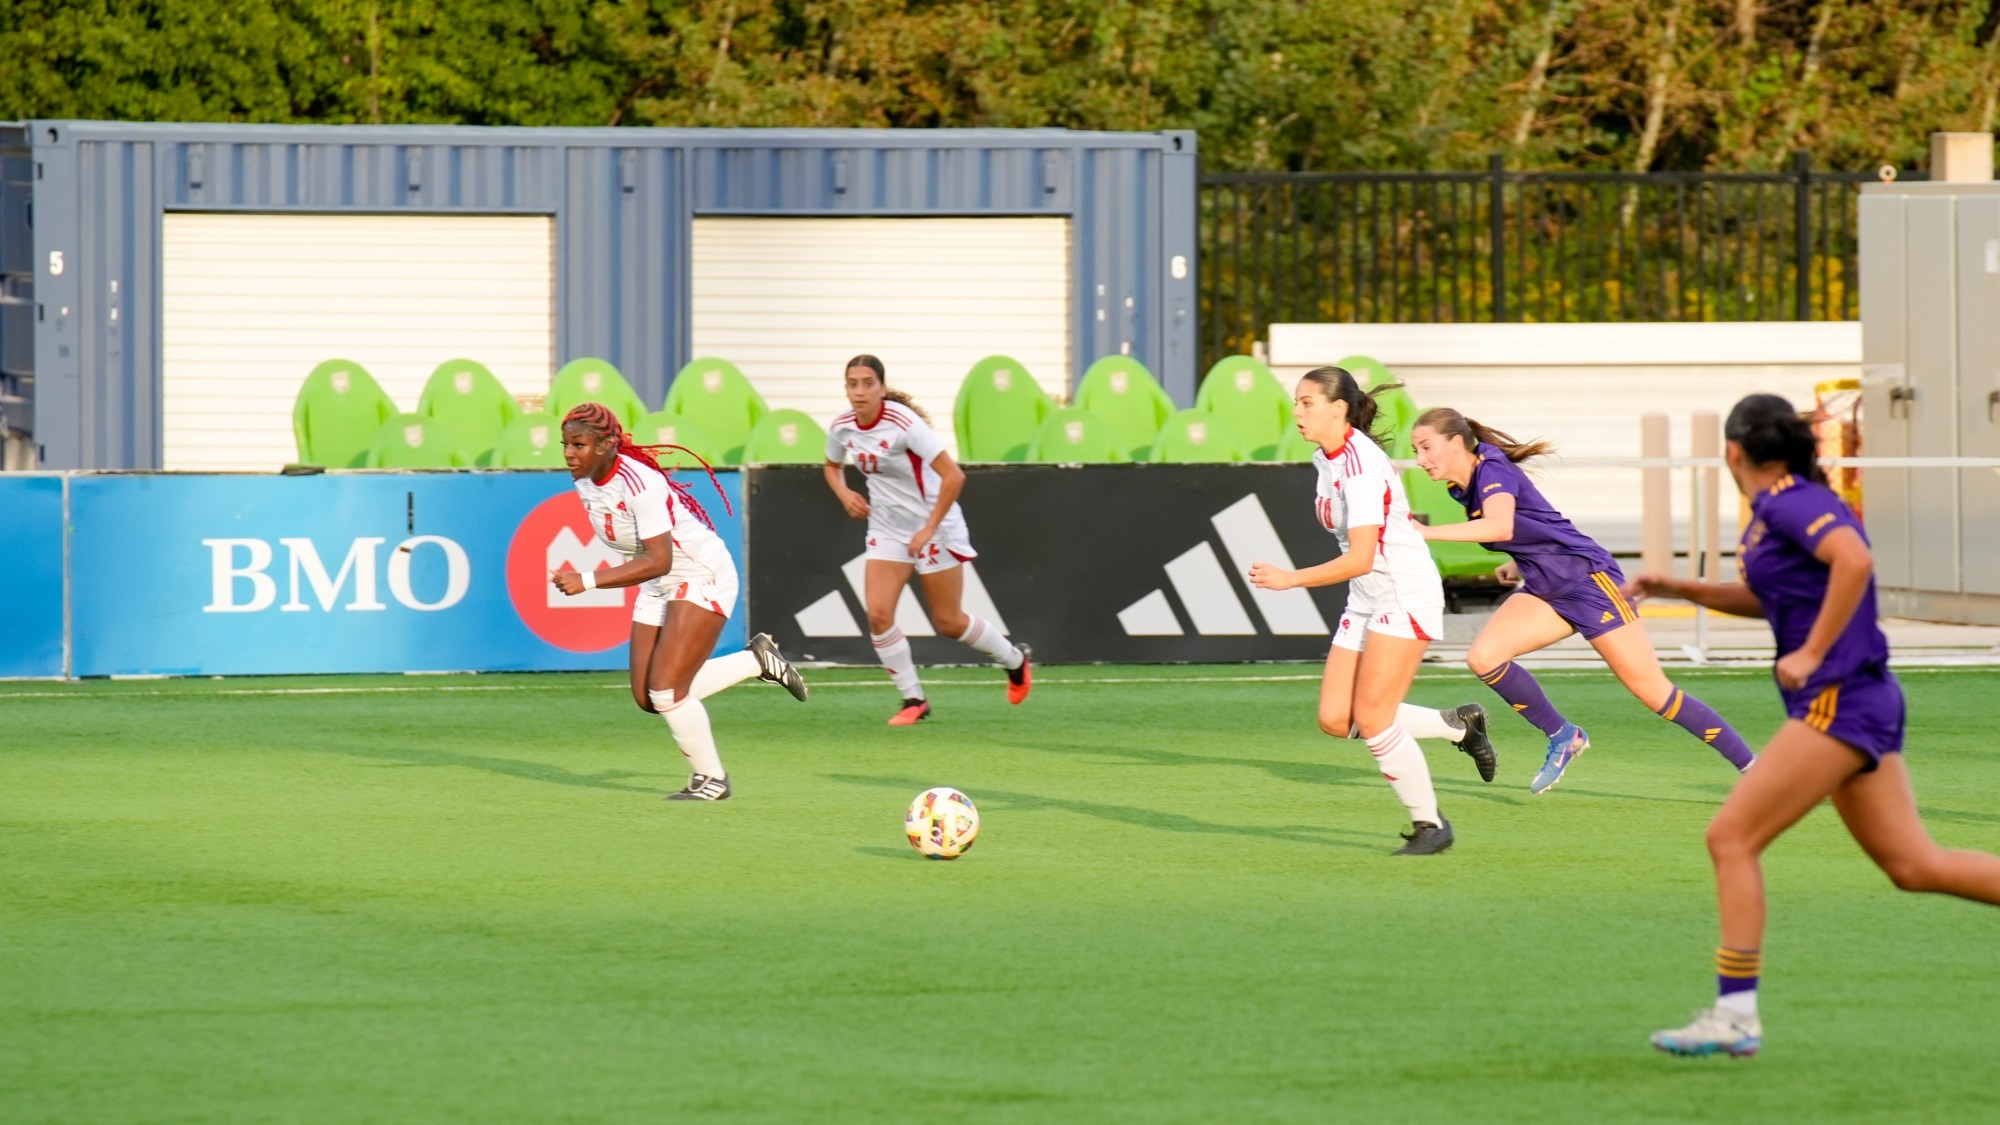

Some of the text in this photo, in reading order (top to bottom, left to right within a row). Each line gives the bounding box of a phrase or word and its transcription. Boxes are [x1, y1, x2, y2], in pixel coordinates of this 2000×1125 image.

[49, 250, 64, 276] 5
[1170, 255, 1187, 280] 6
[858, 452, 882, 475] 22
[201, 534, 471, 613] BMO
